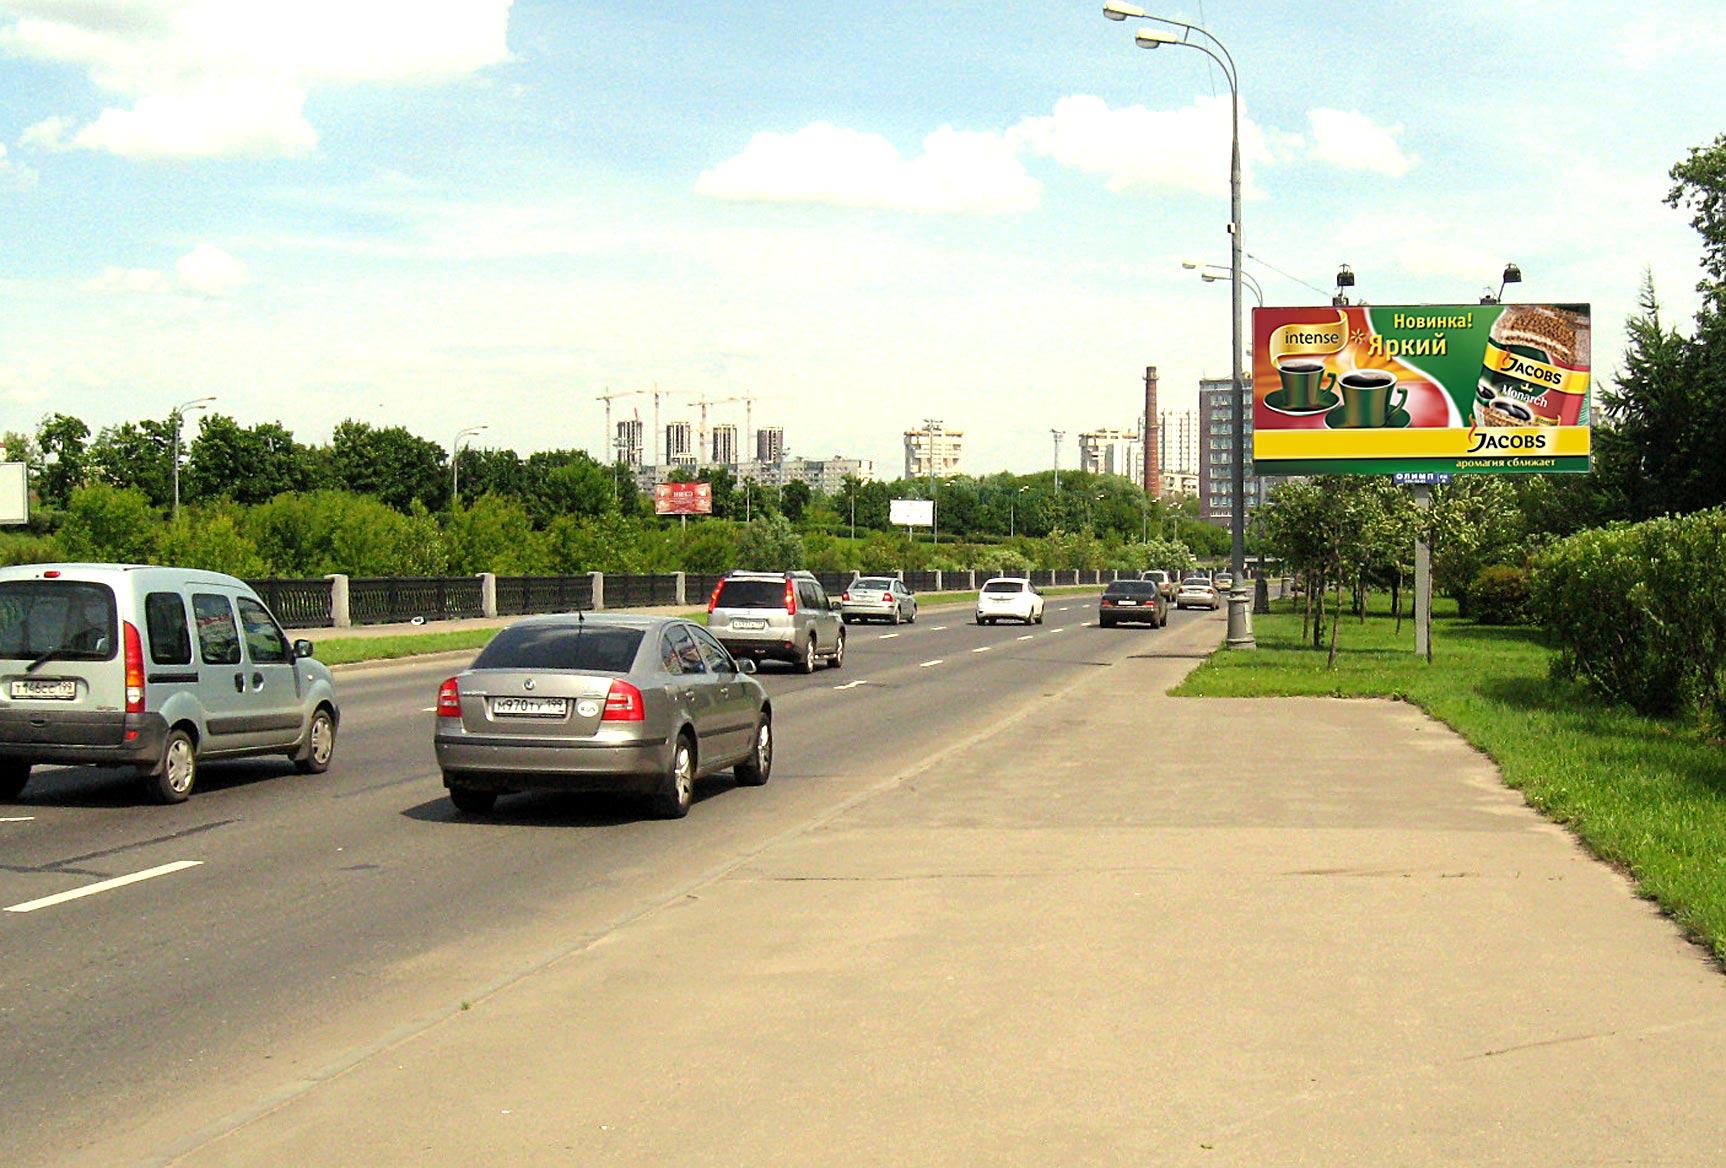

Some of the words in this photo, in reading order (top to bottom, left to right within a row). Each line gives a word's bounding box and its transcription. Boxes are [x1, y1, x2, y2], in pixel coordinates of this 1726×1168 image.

[1394, 312, 1473, 329] Новинка!
[1285, 330, 1339, 345] intense
[1367, 332, 1447, 362] Яркий
[1500, 356, 1562, 385] JACOBS
[1502, 384, 1548, 408] Monarch
[1467, 433, 1546, 453] JACOBS
